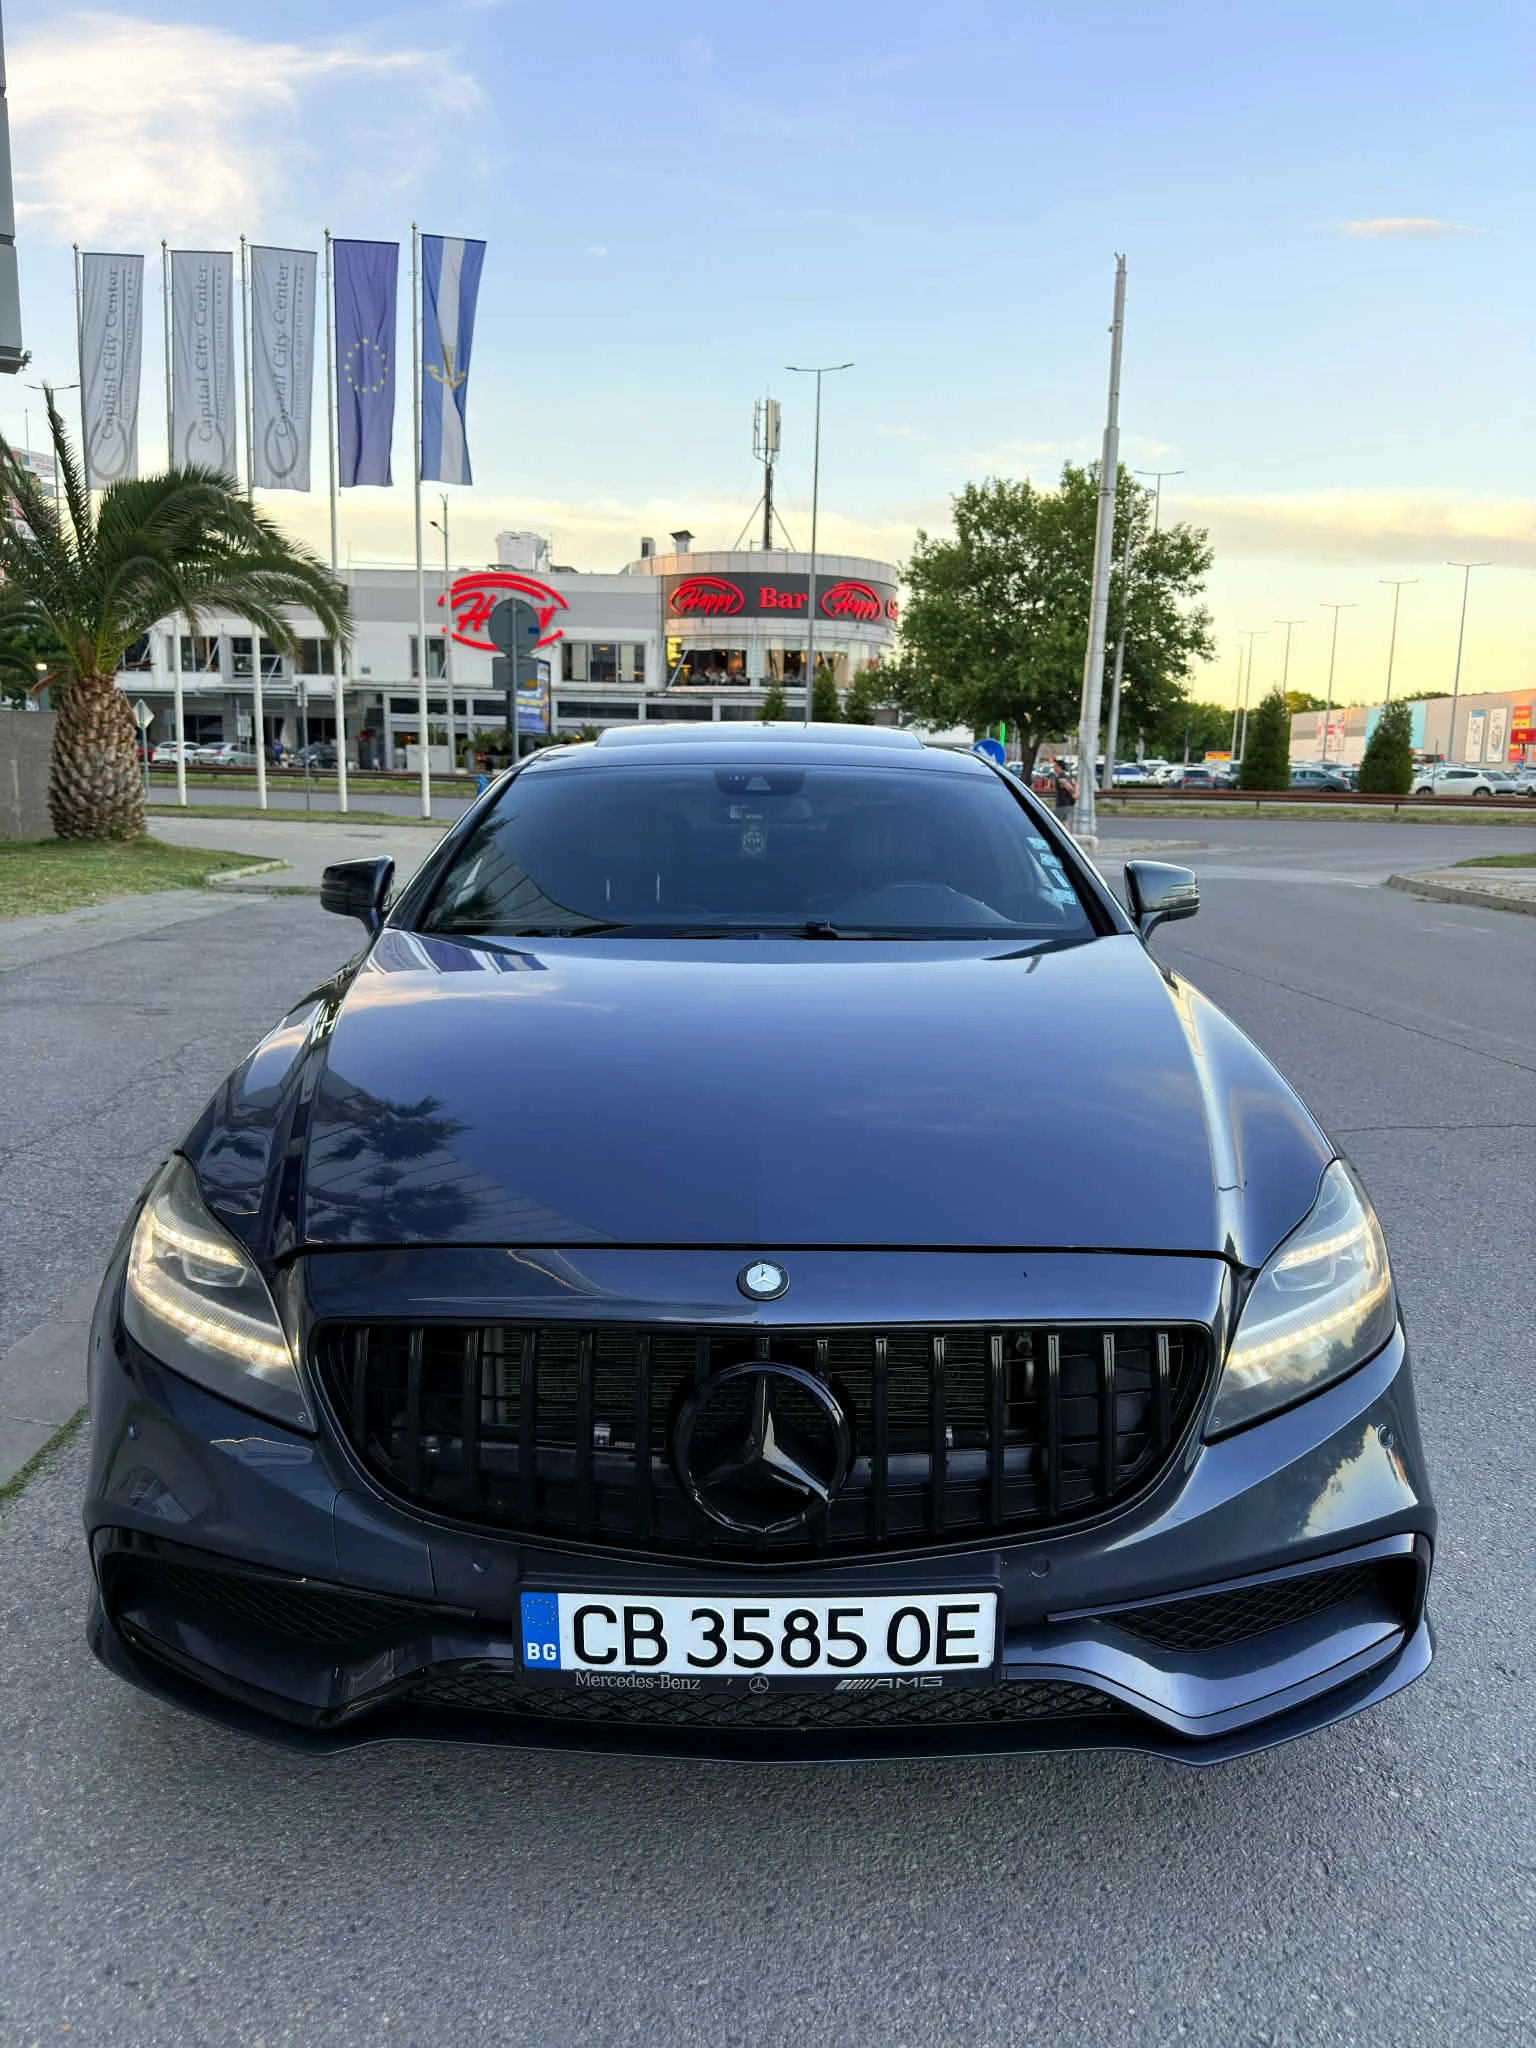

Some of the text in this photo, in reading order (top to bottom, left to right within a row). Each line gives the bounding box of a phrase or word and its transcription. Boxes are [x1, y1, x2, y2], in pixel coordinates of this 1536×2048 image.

[273, 262, 289, 325] Center
[102, 267, 121, 441] Capital City Center
[195, 264, 215, 442] Capital City Center
[273, 328, 291, 369] City
[677, 586, 737, 616] Happy
[759, 587, 808, 609] Bar
[829, 590, 879, 621] Happy
[527, 1642, 557, 1661] BG
[573, 1604, 980, 1669] CB 3585 OE
[575, 1671, 701, 1690] Mercedes-Benz
[872, 1676, 944, 1690] AMG
